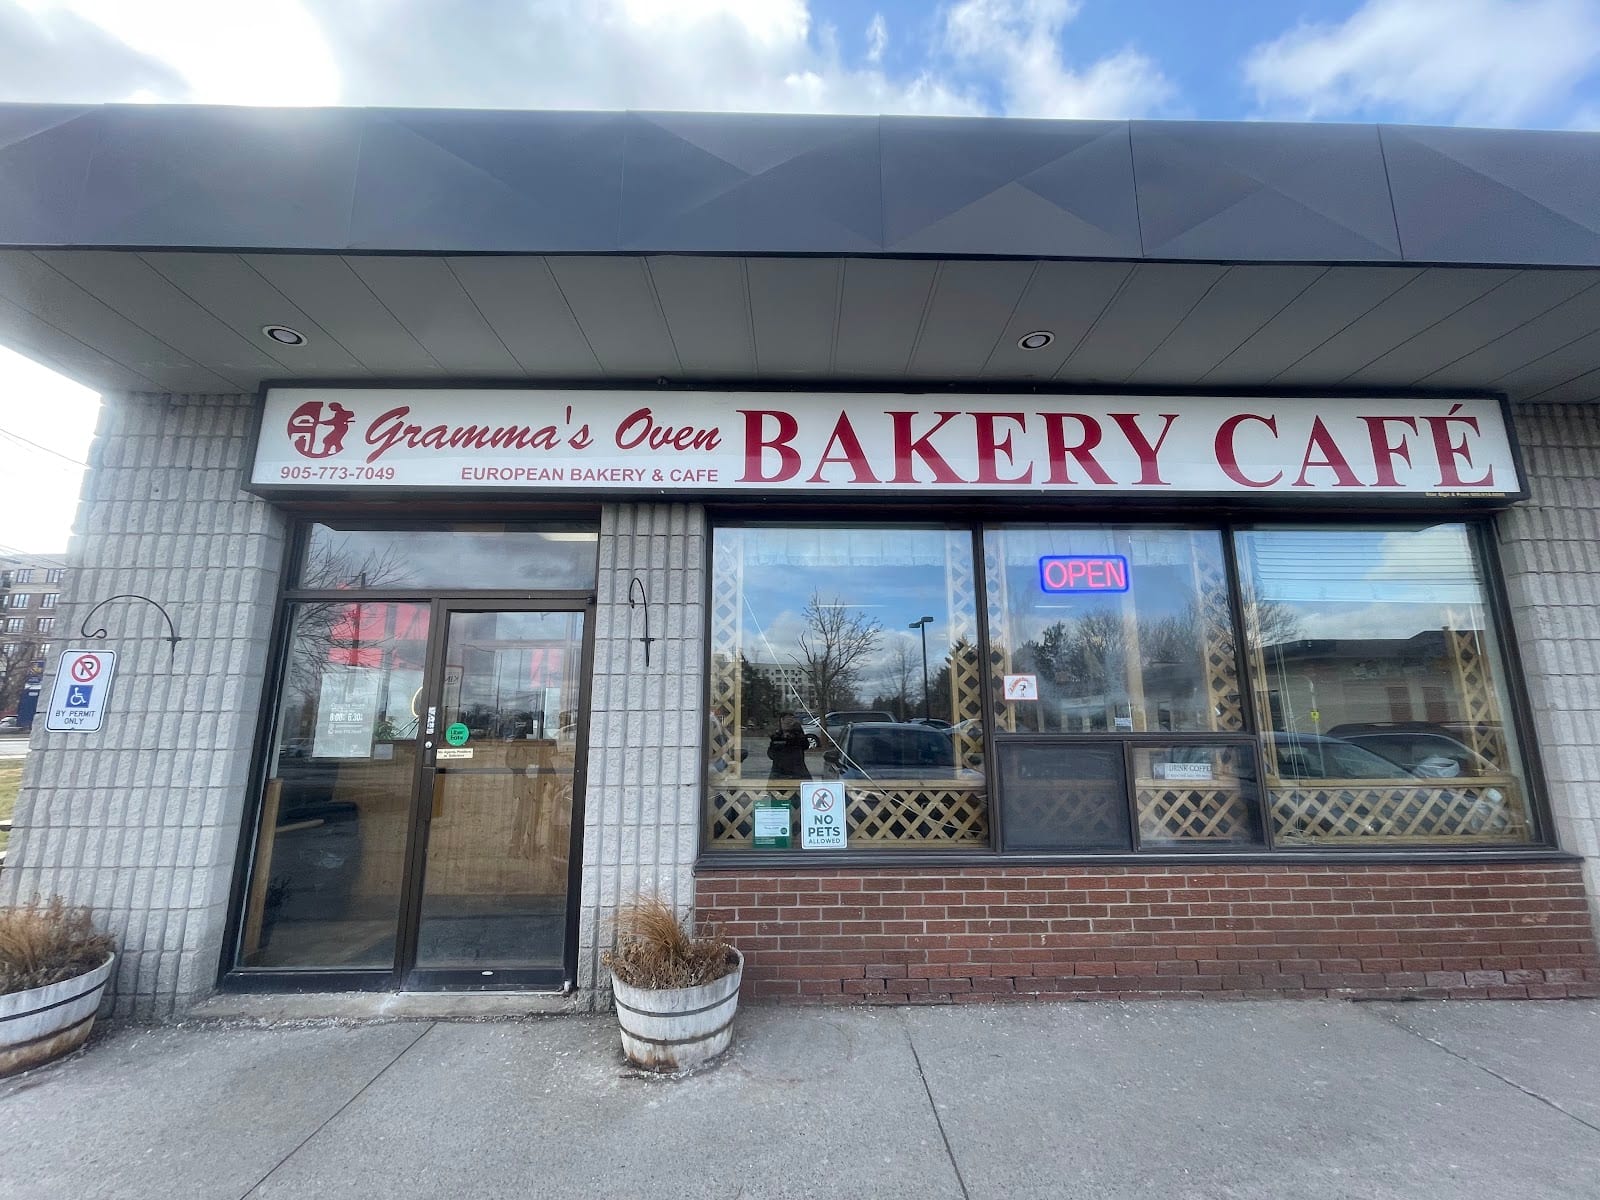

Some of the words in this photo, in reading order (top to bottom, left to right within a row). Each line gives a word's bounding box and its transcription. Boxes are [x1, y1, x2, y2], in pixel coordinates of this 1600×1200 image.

[365, 405, 593, 464] Gramma's
[615, 407, 722, 451] Oven
[735, 410, 1179, 486] BAKERY
[1214, 403, 1494, 487] CAFÉ
[280, 466, 395, 480] 905-773-7049
[461, 467, 564, 481] EUROPEAN
[570, 468, 646, 482] BAKERY
[651, 469, 664, 482] &
[669, 469, 718, 482] CAFE
[1044, 560, 1126, 589] OPEN
[63, 717, 85, 725] ONLY
[814, 814, 834, 825] NO
[808, 826, 841, 837] PETS
